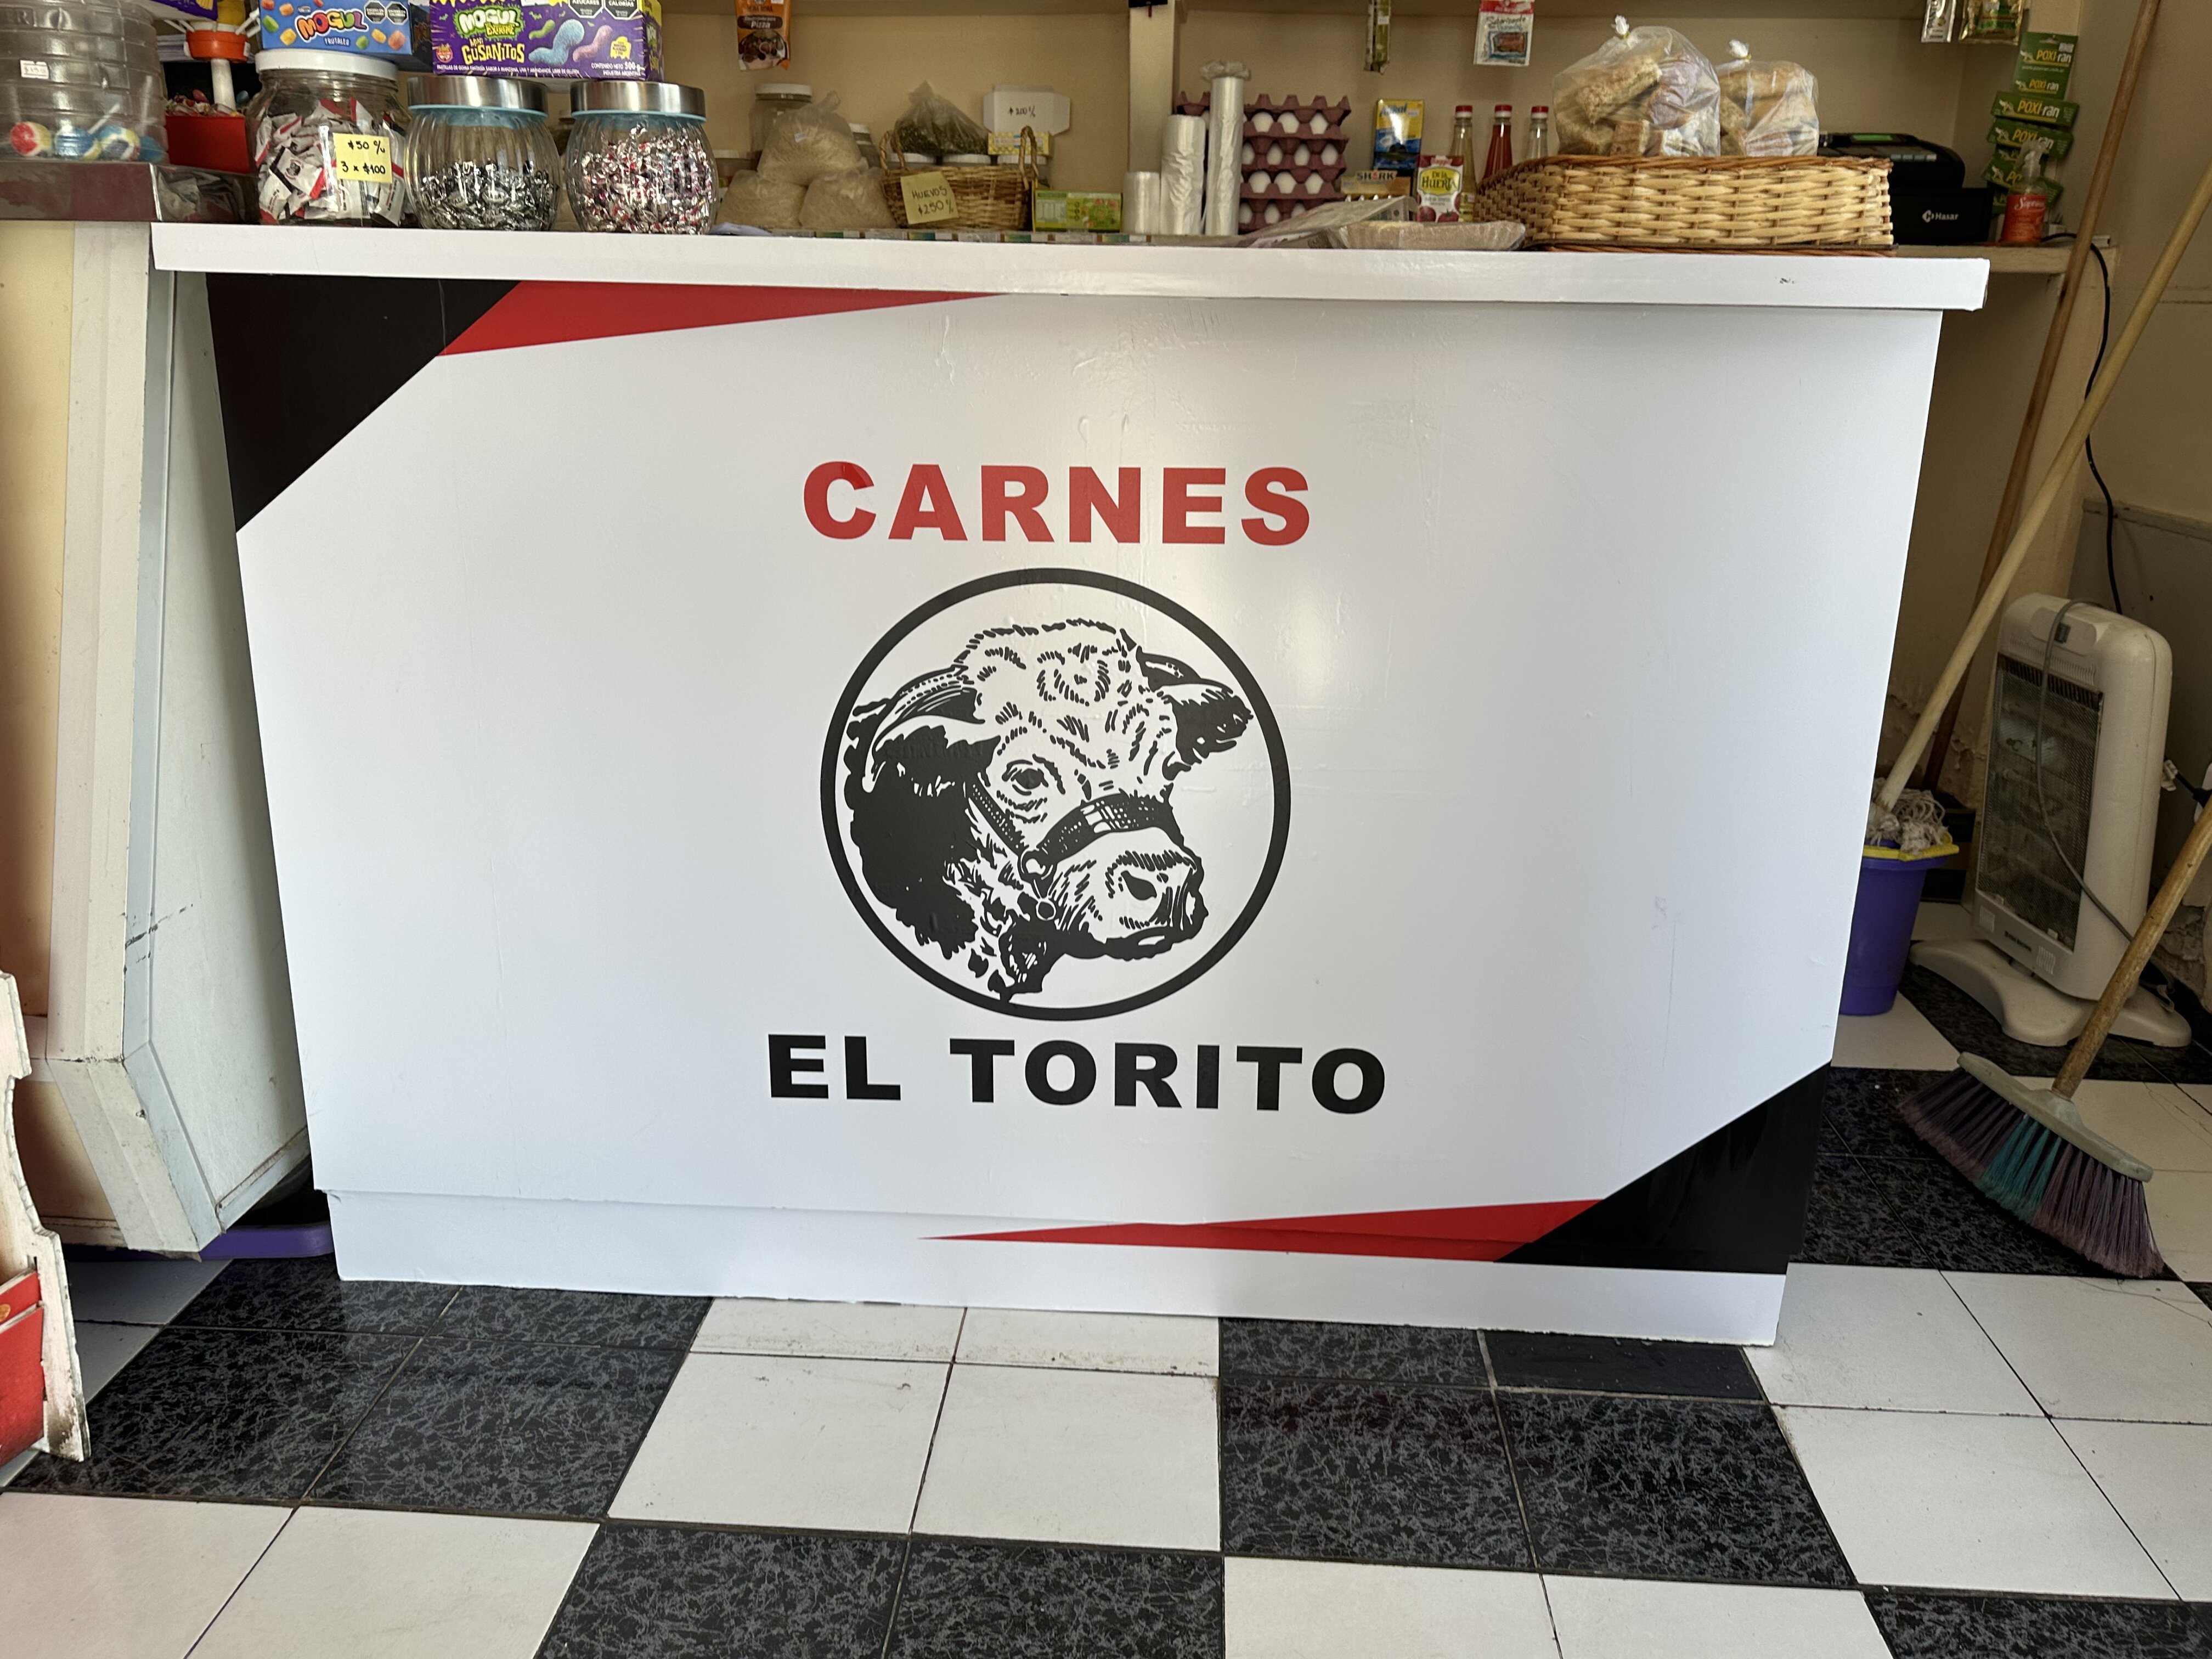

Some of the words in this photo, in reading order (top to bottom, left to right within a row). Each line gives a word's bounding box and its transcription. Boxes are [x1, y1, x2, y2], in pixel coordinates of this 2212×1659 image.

[296, 10, 368, 41] MOGUL
[459, 9, 520, 34] MOGUL
[751, 20, 771, 29] Pizza
[485, 24, 515, 36] EXTREME
[324, 36, 350, 47] FRUTALES
[461, 42, 525, 65] GUSANITOS
[348, 139, 369, 151] $50
[341, 160, 349, 173] 3
[363, 162, 386, 175] $100
[911, 185, 948, 200] HUEVOS
[1935, 212, 1959, 221] Hasar
[804, 462, 1309, 545] CARNES
[769, 1035, 900, 1100] EL
[950, 1039, 1385, 1114] TORITO
